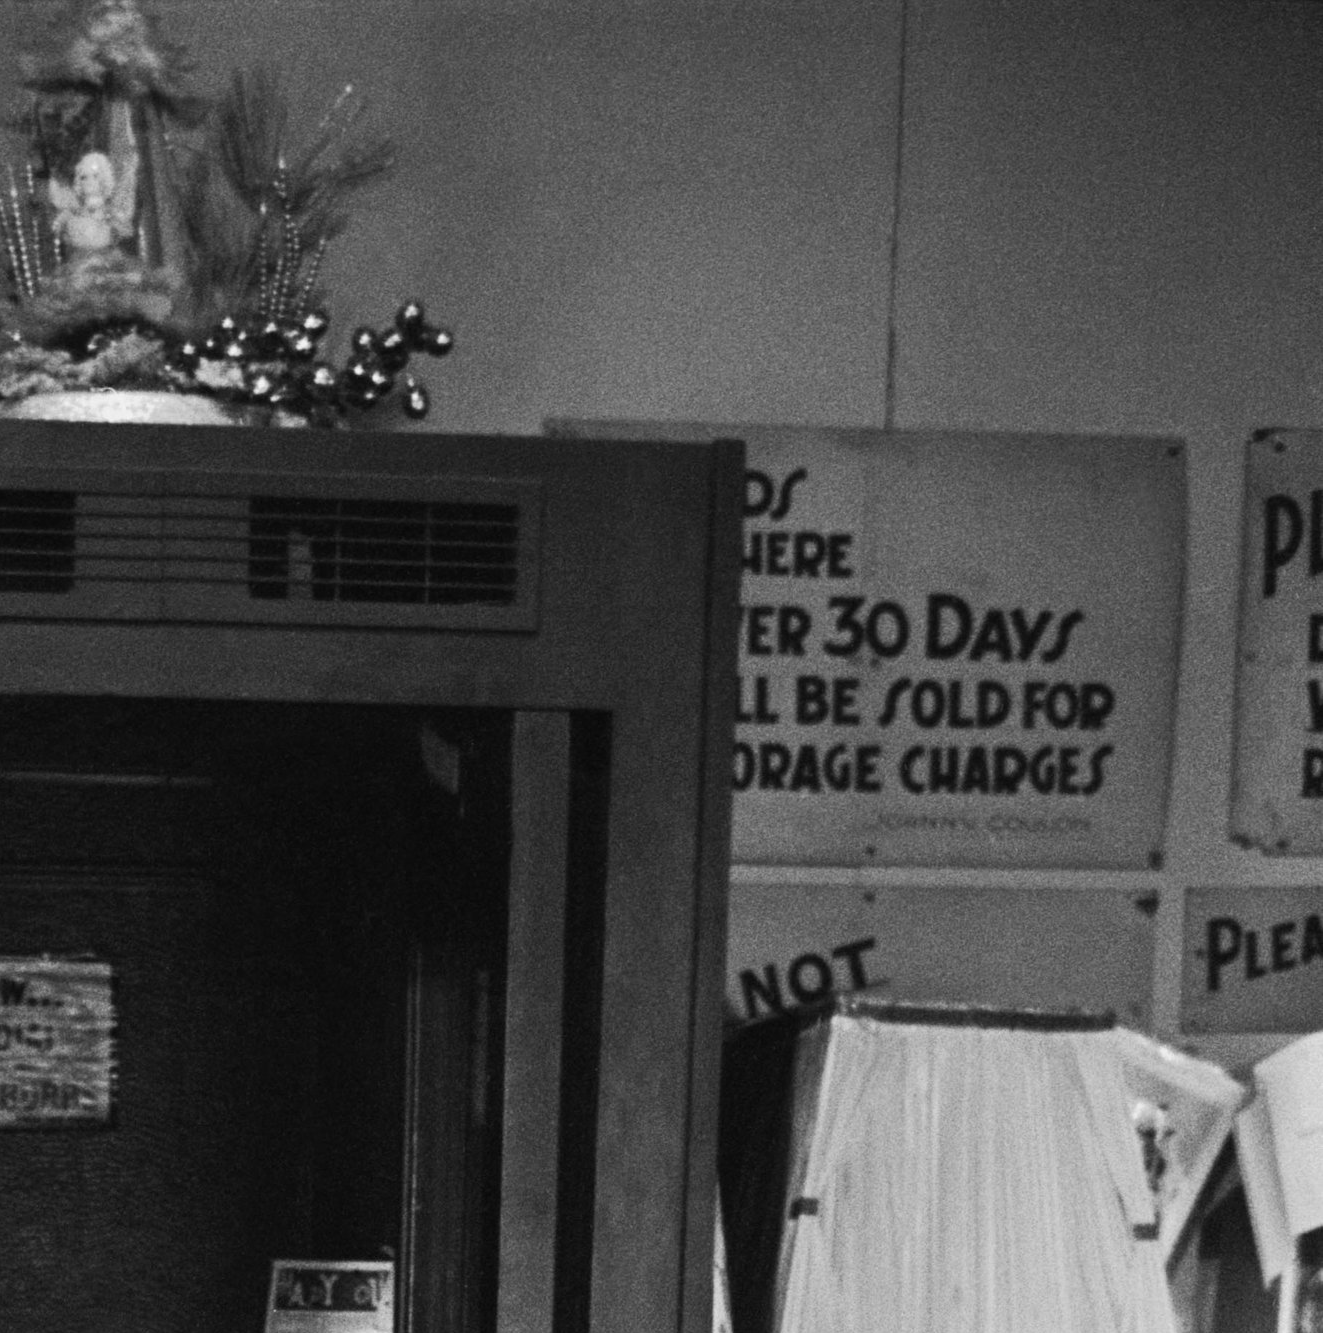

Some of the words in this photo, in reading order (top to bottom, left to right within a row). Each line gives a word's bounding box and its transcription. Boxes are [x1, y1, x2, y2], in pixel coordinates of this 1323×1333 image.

[824, 596, 909, 658] 30
[925, 593, 1084, 663] DAYS
[796, 675, 861, 727] BE
[878, 677, 1011, 729] SOLD
[1021, 681, 1115, 730] FOR
[899, 745, 1114, 796] CHARGES
[739, 936, 874, 1020] NOT
